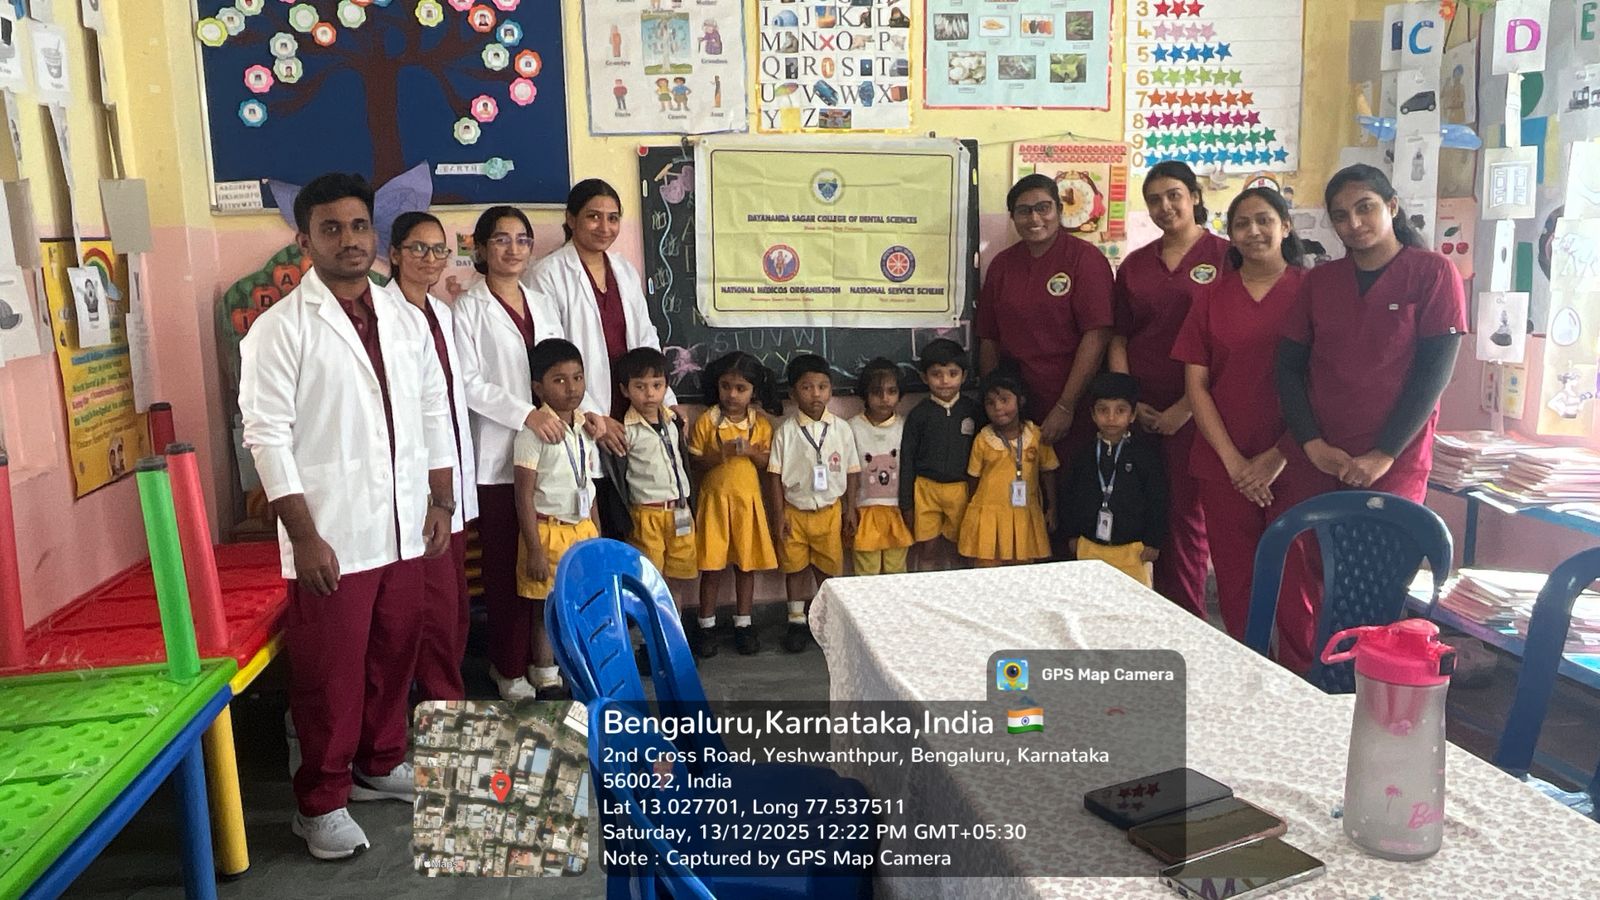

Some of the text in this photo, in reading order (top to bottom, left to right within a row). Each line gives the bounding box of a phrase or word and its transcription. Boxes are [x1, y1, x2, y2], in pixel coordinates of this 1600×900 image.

[763, 6, 890, 27] I J K L
[1136, 1, 1149, 17] 3
[1581, 2, 1598, 40] E
[1136, 21, 1151, 39] 4
[1409, 20, 1434, 54] C
[1506, 18, 1541, 53] D
[760, 30, 891, 51] M N O P
[1136, 46, 1149, 63] 5
[762, 55, 891, 80] Q R S T
[1136, 69, 1149, 85] 6
[760, 82, 893, 104] U V W X
[1135, 91, 1149, 108] 7
[763, 108, 818, 129] Y Z
[1133, 113, 1144, 129] 8
[1132, 133, 1144, 150] 9
[747, 214, 918, 225] DAYANANDA SAGAR COLLEGE OF DENTAL SCIENCES
[281, 273, 293, 286] A
[721, 286, 755, 294] NATIONAL
[757, 286, 788, 294] MEDICOS
[850, 286, 945, 296] NATIONAL SERVICE SCHEME
